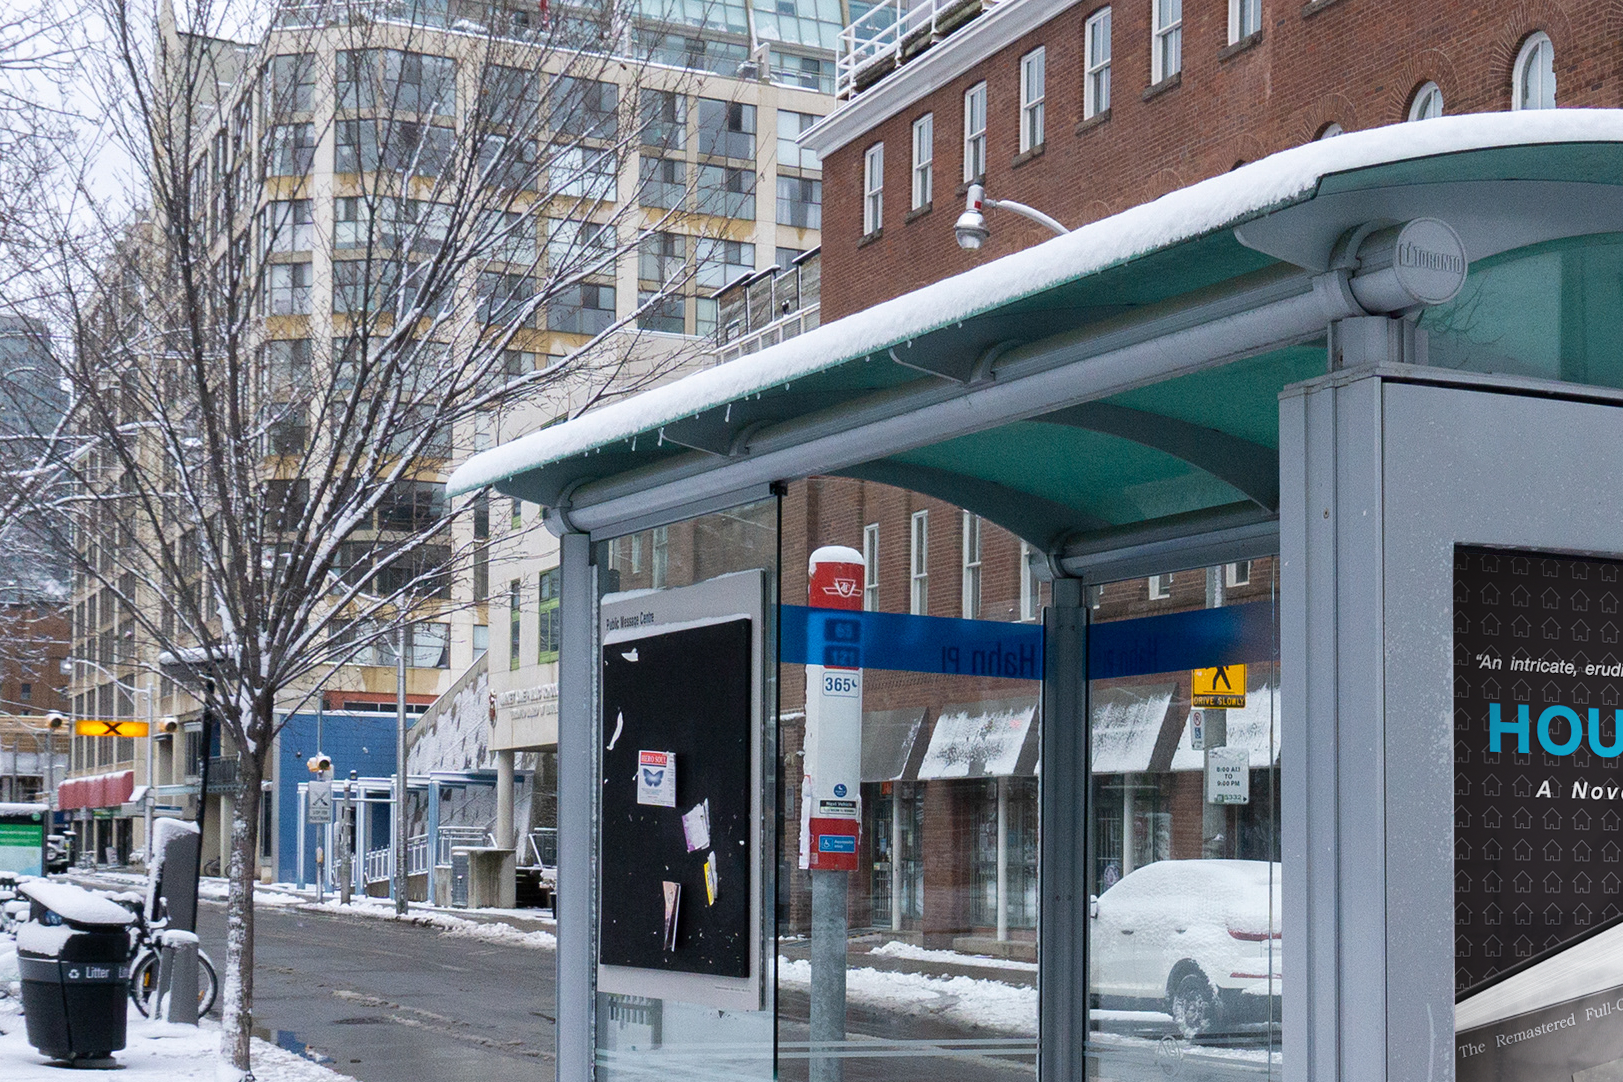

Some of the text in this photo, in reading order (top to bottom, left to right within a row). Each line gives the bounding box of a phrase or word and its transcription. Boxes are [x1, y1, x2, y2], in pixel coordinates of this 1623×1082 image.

[1413, 246, 1462, 274] TORONTO
[620, 614, 639, 629] Message
[640, 611, 655, 625] Centre
[1510, 656, 1577, 677] intricate,
[825, 677, 851, 692] 365
[1193, 696, 1245, 706] DRIVE SLOWLY
[1535, 780, 1552, 798] A
[85, 966, 110, 979] Litter
[1458, 1040, 1486, 1059] The
[1495, 1013, 1576, 1048] Remastered
